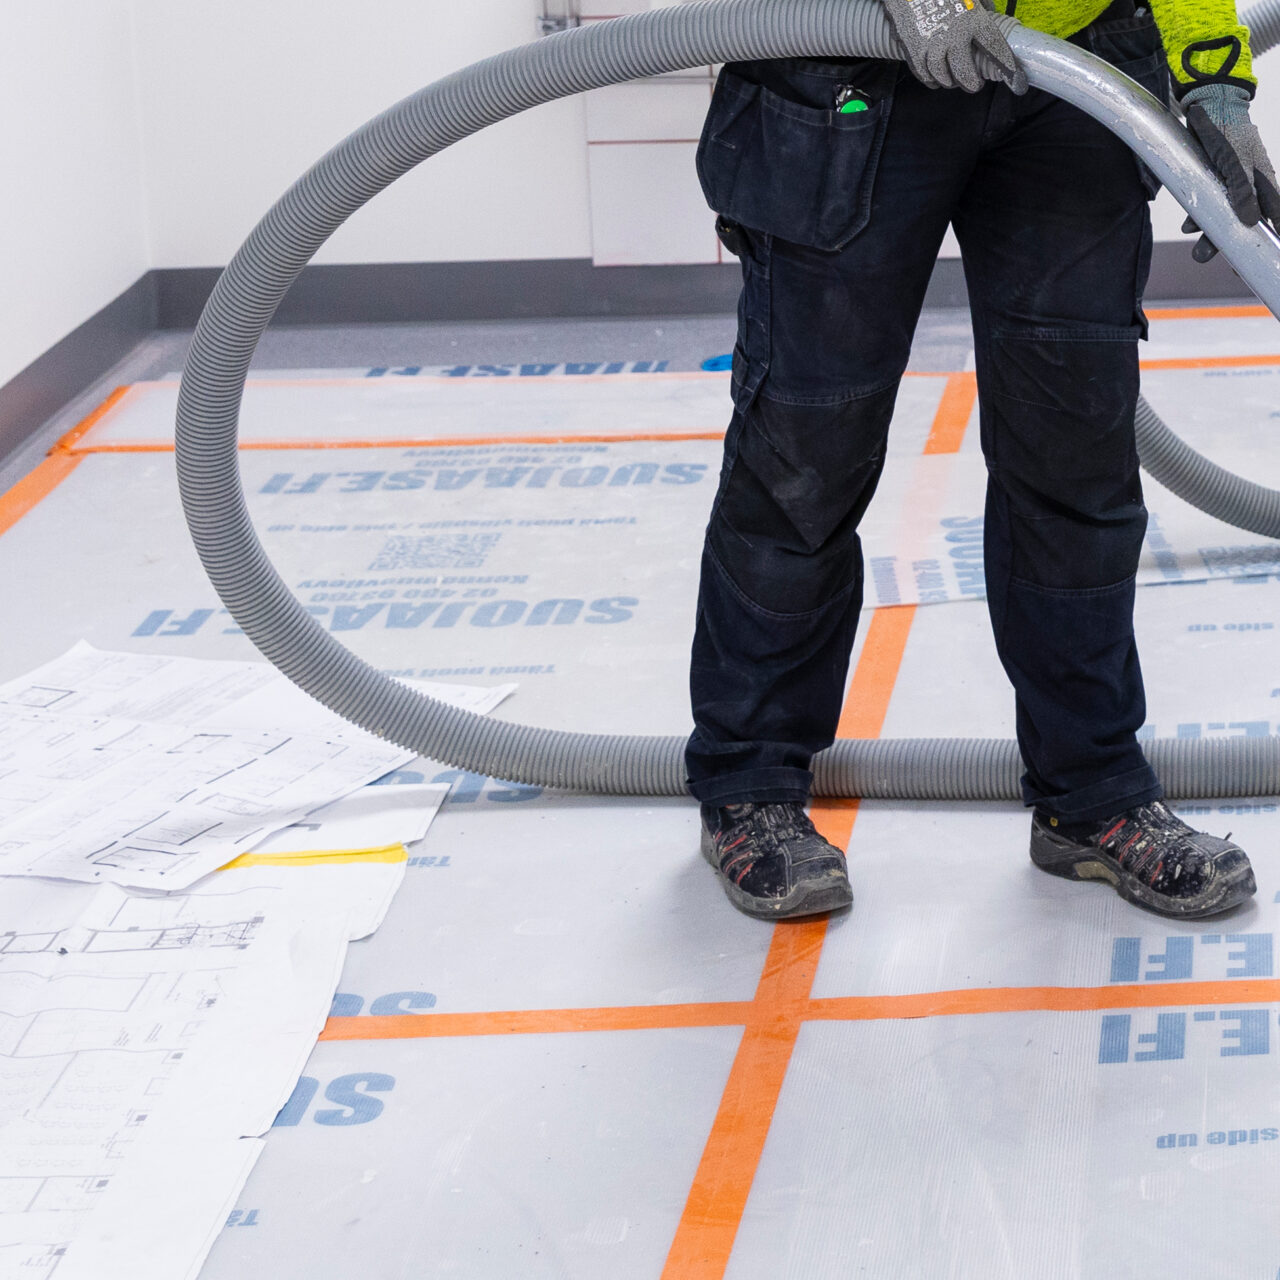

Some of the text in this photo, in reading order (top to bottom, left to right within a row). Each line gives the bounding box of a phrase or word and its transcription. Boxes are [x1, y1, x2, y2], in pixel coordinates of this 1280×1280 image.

[955, 3, 964, 12] 8
[257, 463, 709, 495] SUOJAASE.FI
[1218, 804, 1277, 816] side
[1155, 1131, 1199, 1151] up
[1206, 1127, 1280, 1146] side
